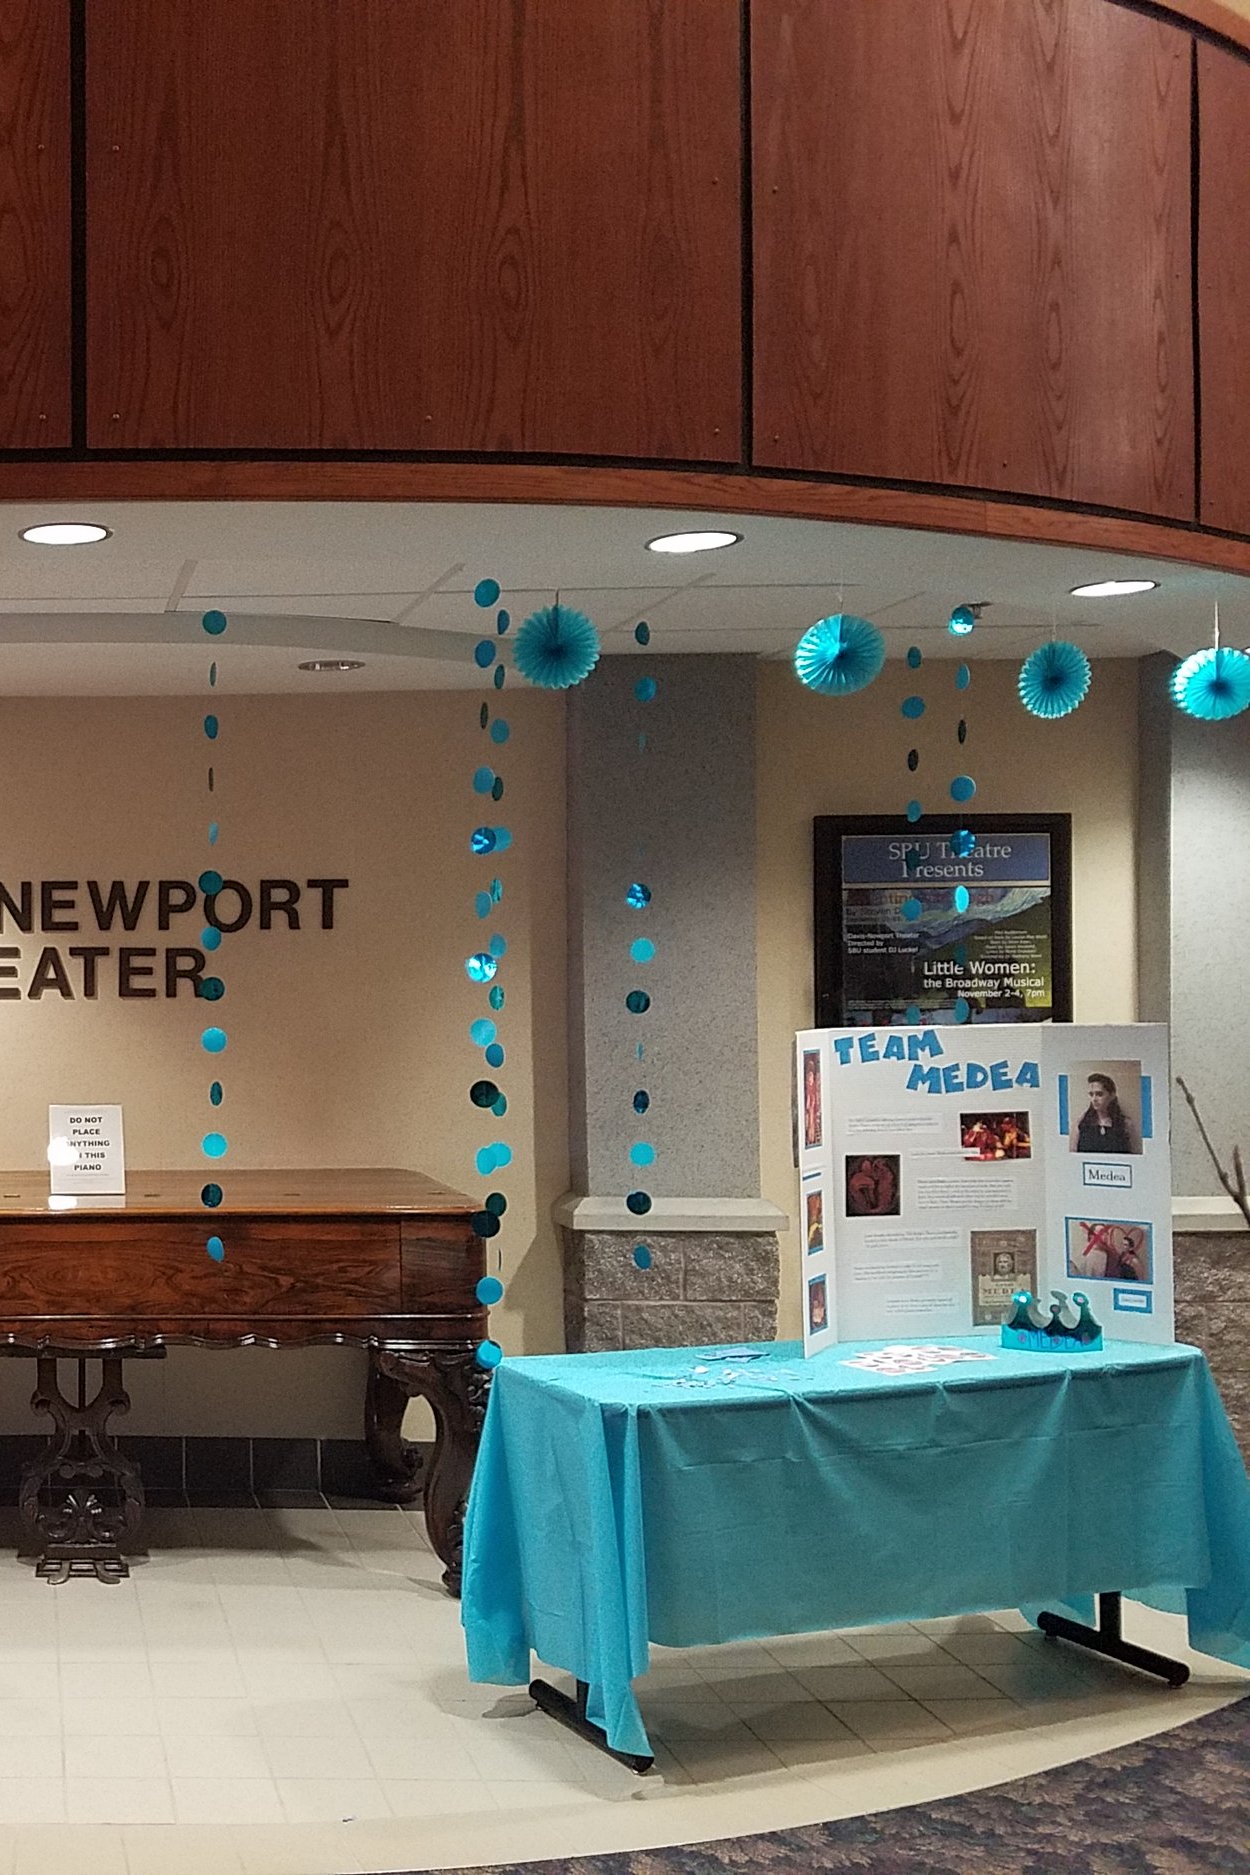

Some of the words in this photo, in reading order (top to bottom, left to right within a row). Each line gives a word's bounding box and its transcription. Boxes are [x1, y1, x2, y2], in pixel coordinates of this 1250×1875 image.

[936, 841, 1012, 858] Tatre
[924, 961, 964, 975] Little
[970, 961, 1036, 975] Women:
[923, 978, 942, 988] the
[945, 978, 1000, 990] Broadway
[1004, 977, 1045, 987] Musical
[958, 989, 1002, 998] November
[1026, 989, 1045, 998] 7pm
[834, 1029, 944, 1066] TEAM
[906, 1060, 1040, 1094] MEDEA
[73, 1128, 101, 1136] PLACE
[1088, 1168, 1126, 1181] Medea
